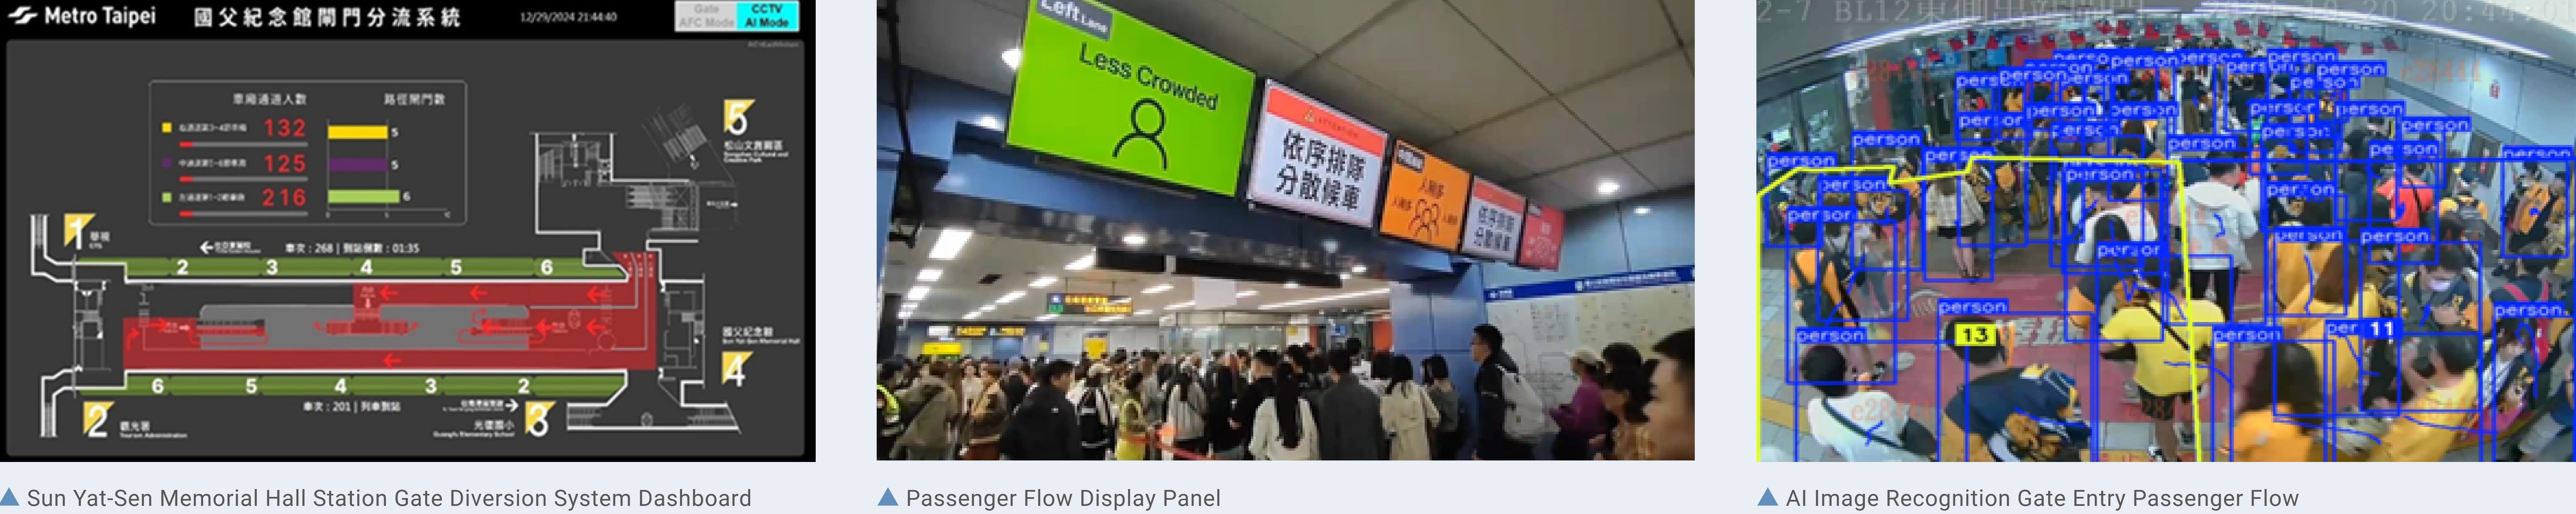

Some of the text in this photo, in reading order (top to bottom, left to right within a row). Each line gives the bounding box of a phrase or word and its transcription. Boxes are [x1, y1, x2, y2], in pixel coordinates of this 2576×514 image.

[694, 4, 720, 13] Gate
[751, 4, 784, 14] CCTV
[45, 6, 156, 29] Metro Taipei
[521, 12, 618, 23] 12/29/2024 21:44:40
[679, 17, 734, 27] AFC Mode
[745, 17, 789, 27] AI Mode
[1079, 42, 1219, 111] Less Crowded
[729, 103, 747, 135] 5
[264, 118, 305, 137] 132
[391, 128, 398, 137] 5
[264, 154, 306, 173] 125
[1282, 128, 1366, 183] 依序排隊
[391, 160, 398, 170] 5
[1274, 164, 1361, 211] 分散候車
[263, 188, 306, 207] 216
[403, 191, 411, 201] 6
[70, 219, 83, 249] 1
[177, 259, 188, 275] 2
[267, 259, 278, 275] 3
[360, 259, 373, 274] 4
[451, 260, 462, 275] 5
[541, 260, 553, 275] 6
[726, 354, 745, 387] 4
[152, 379, 164, 394] 6
[246, 378, 257, 394] 5
[335, 378, 347, 393] 4
[426, 378, 437, 394] 3
[519, 379, 529, 394] 2
[89, 405, 107, 438] 2
[530, 404, 549, 437] 3
